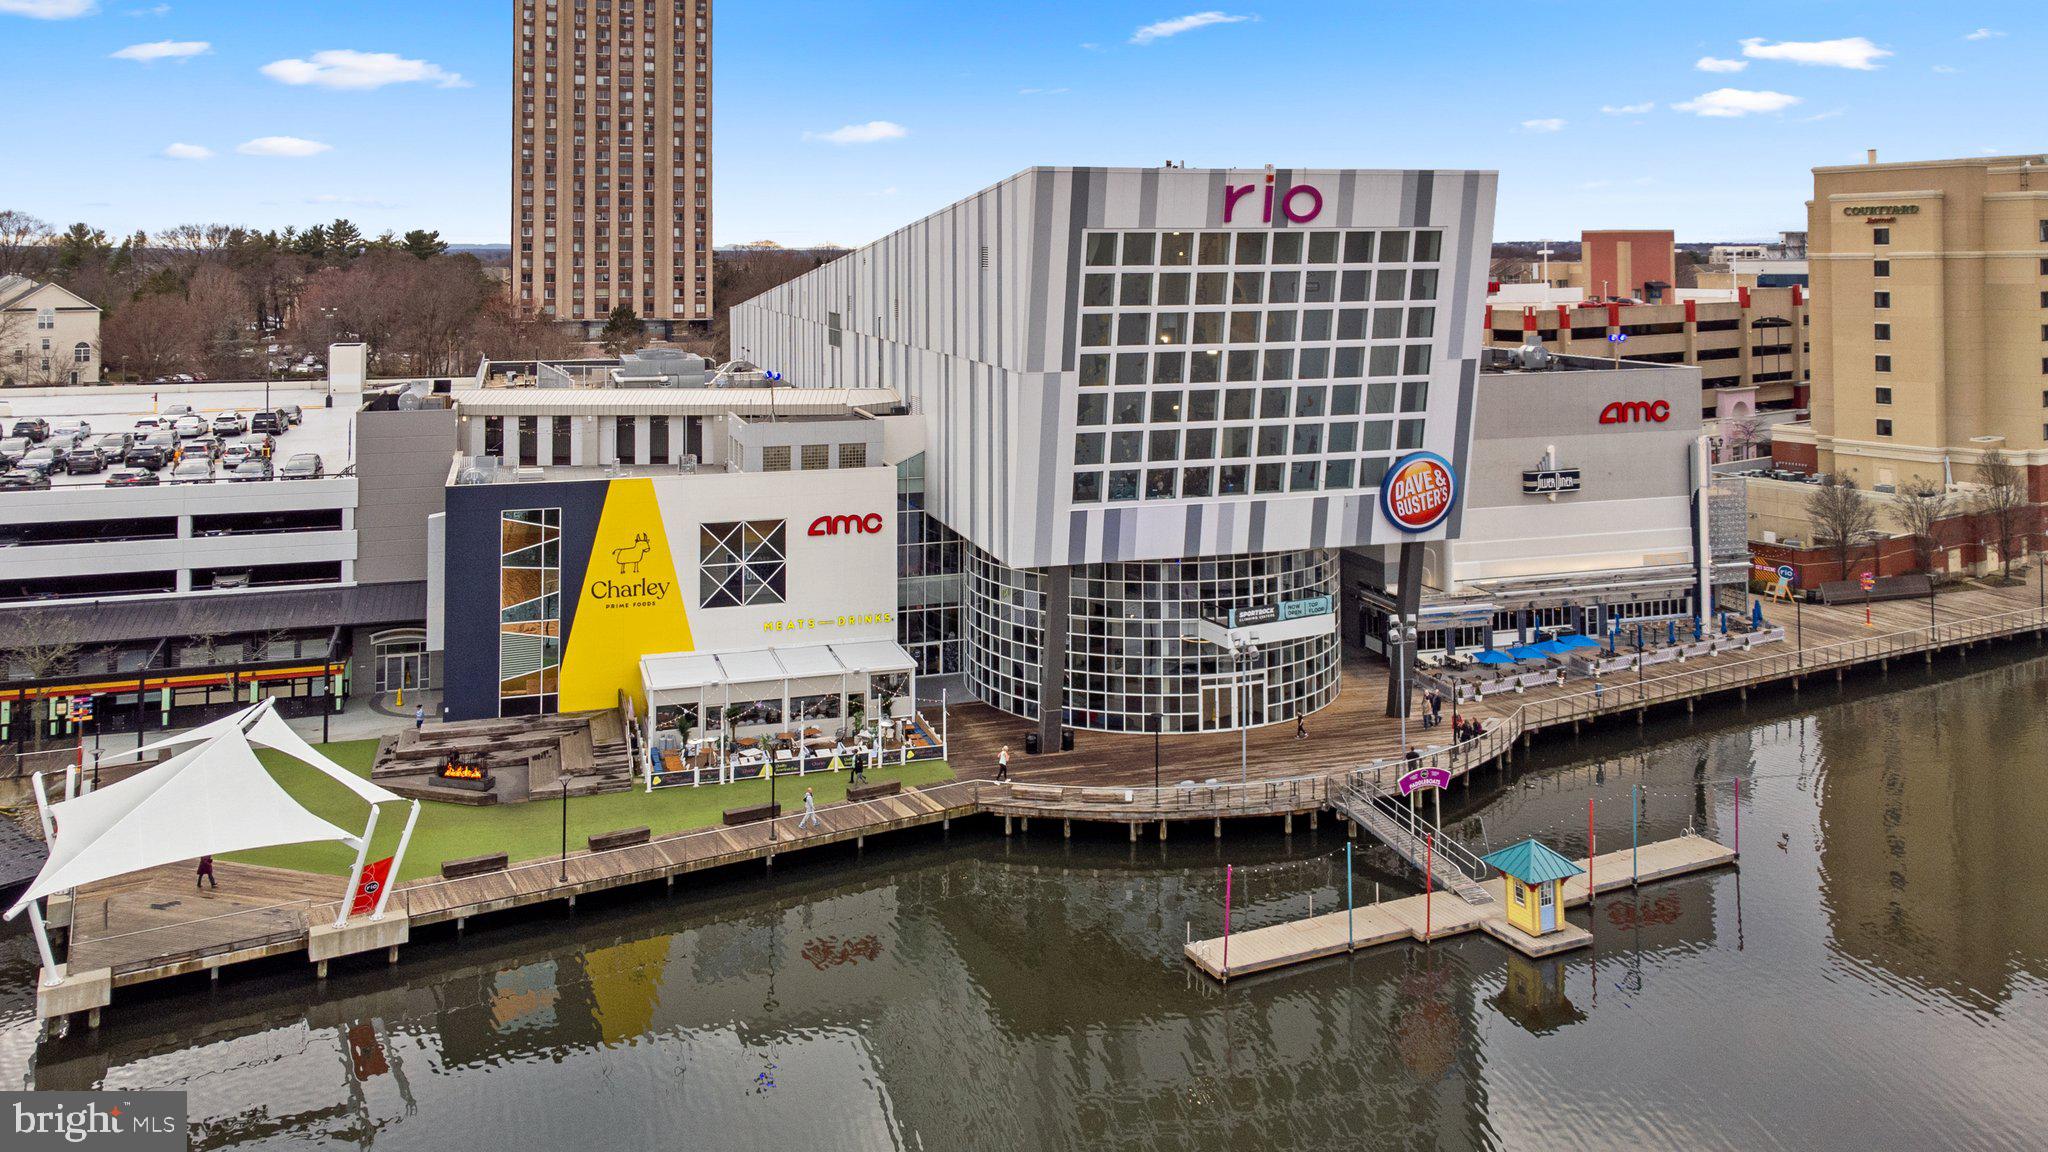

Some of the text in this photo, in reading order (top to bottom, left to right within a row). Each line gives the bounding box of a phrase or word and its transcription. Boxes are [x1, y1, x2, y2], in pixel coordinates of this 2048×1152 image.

[1223, 174, 1323, 224] rio
[1395, 469, 1447, 501] DAVE &
[1396, 486, 1448, 517] BUSTER'S
[1780, 567, 1793, 576] rio
[591, 577, 670, 600] Charley
[763, 613, 891, 632] MEATS DRINKS
